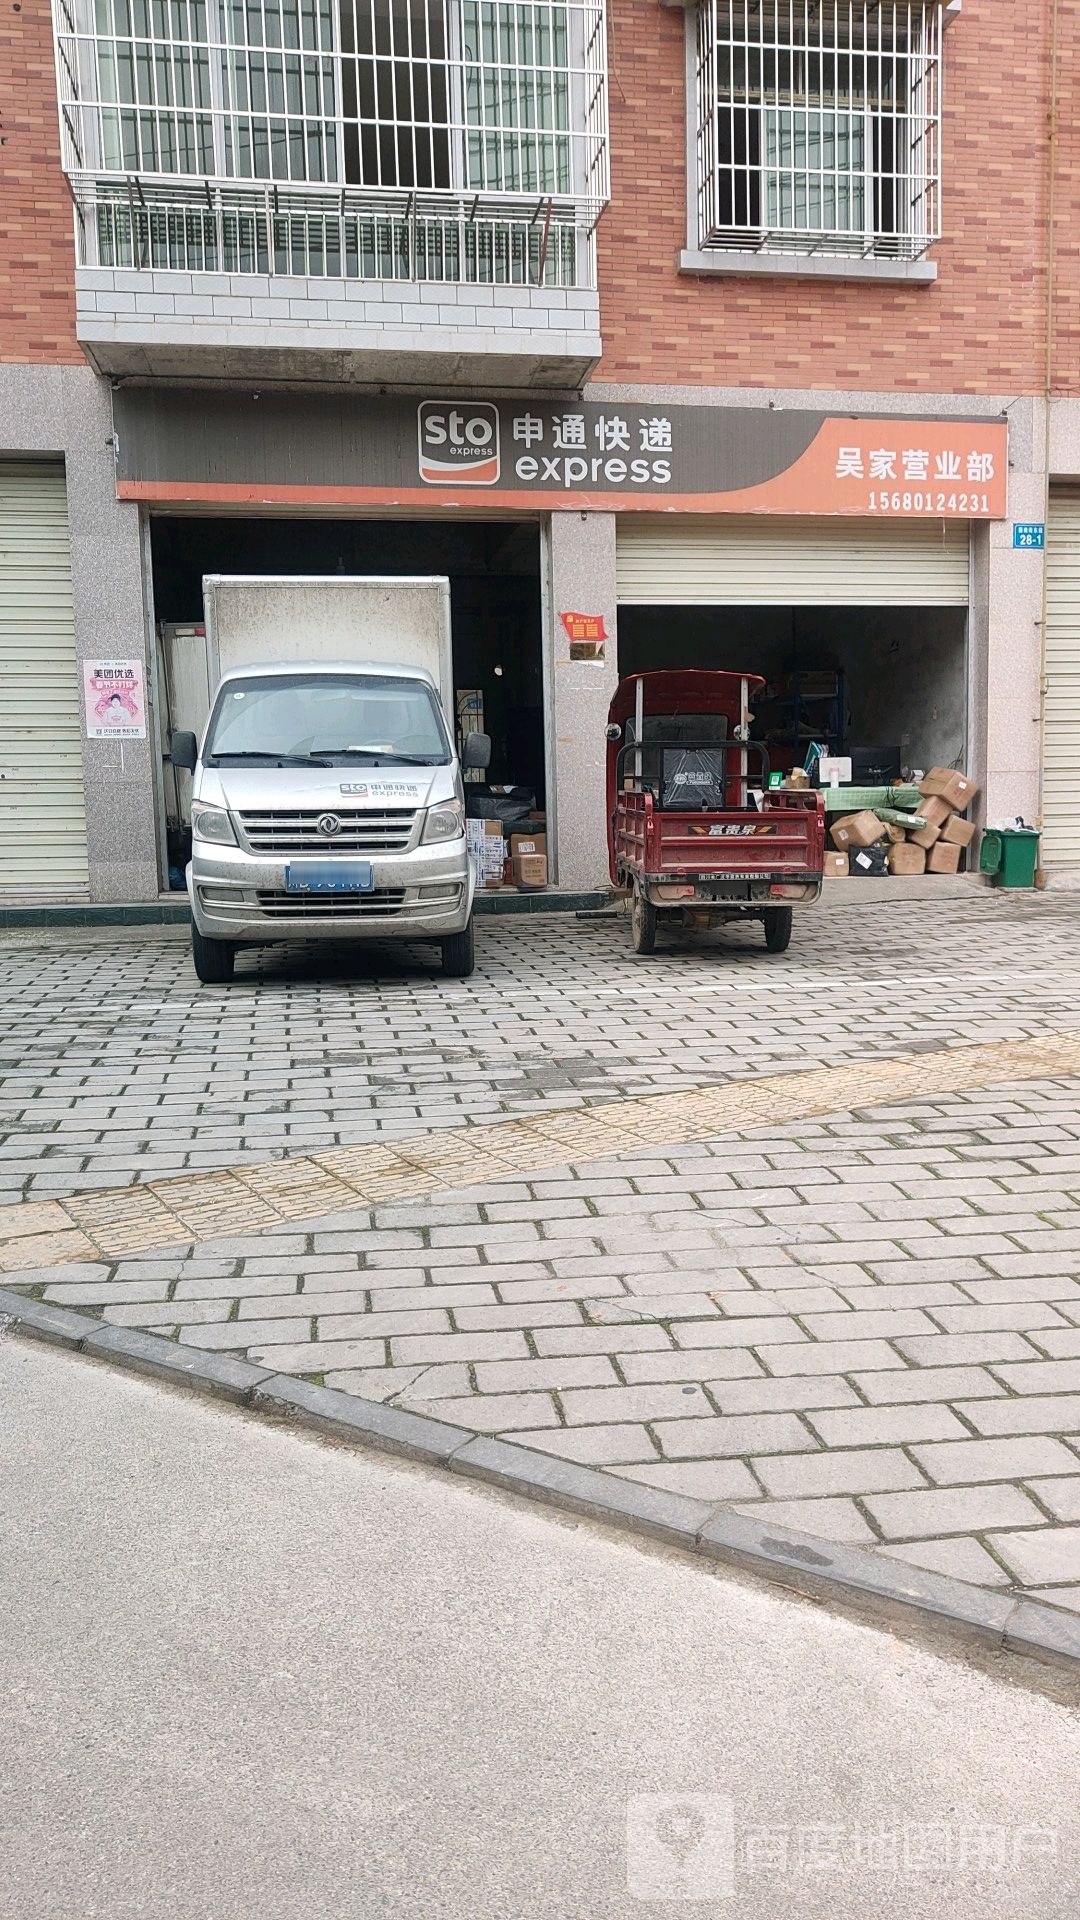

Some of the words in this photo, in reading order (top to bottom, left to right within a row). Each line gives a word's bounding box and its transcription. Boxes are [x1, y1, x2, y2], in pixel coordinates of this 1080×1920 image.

[425, 410, 493, 446] sto
[513, 412, 673, 453] 申通快递
[450, 445, 493, 457] express
[515, 456, 673, 487] express
[835, 447, 995, 483] 吴家营业部
[868, 491, 990, 513] 15680124231
[1020, 534, 1042, 546] 28-1
[94, 669, 135, 679] 美团优选
[372, 790, 419, 798] express
[709, 824, 757, 836] 富贵泉
